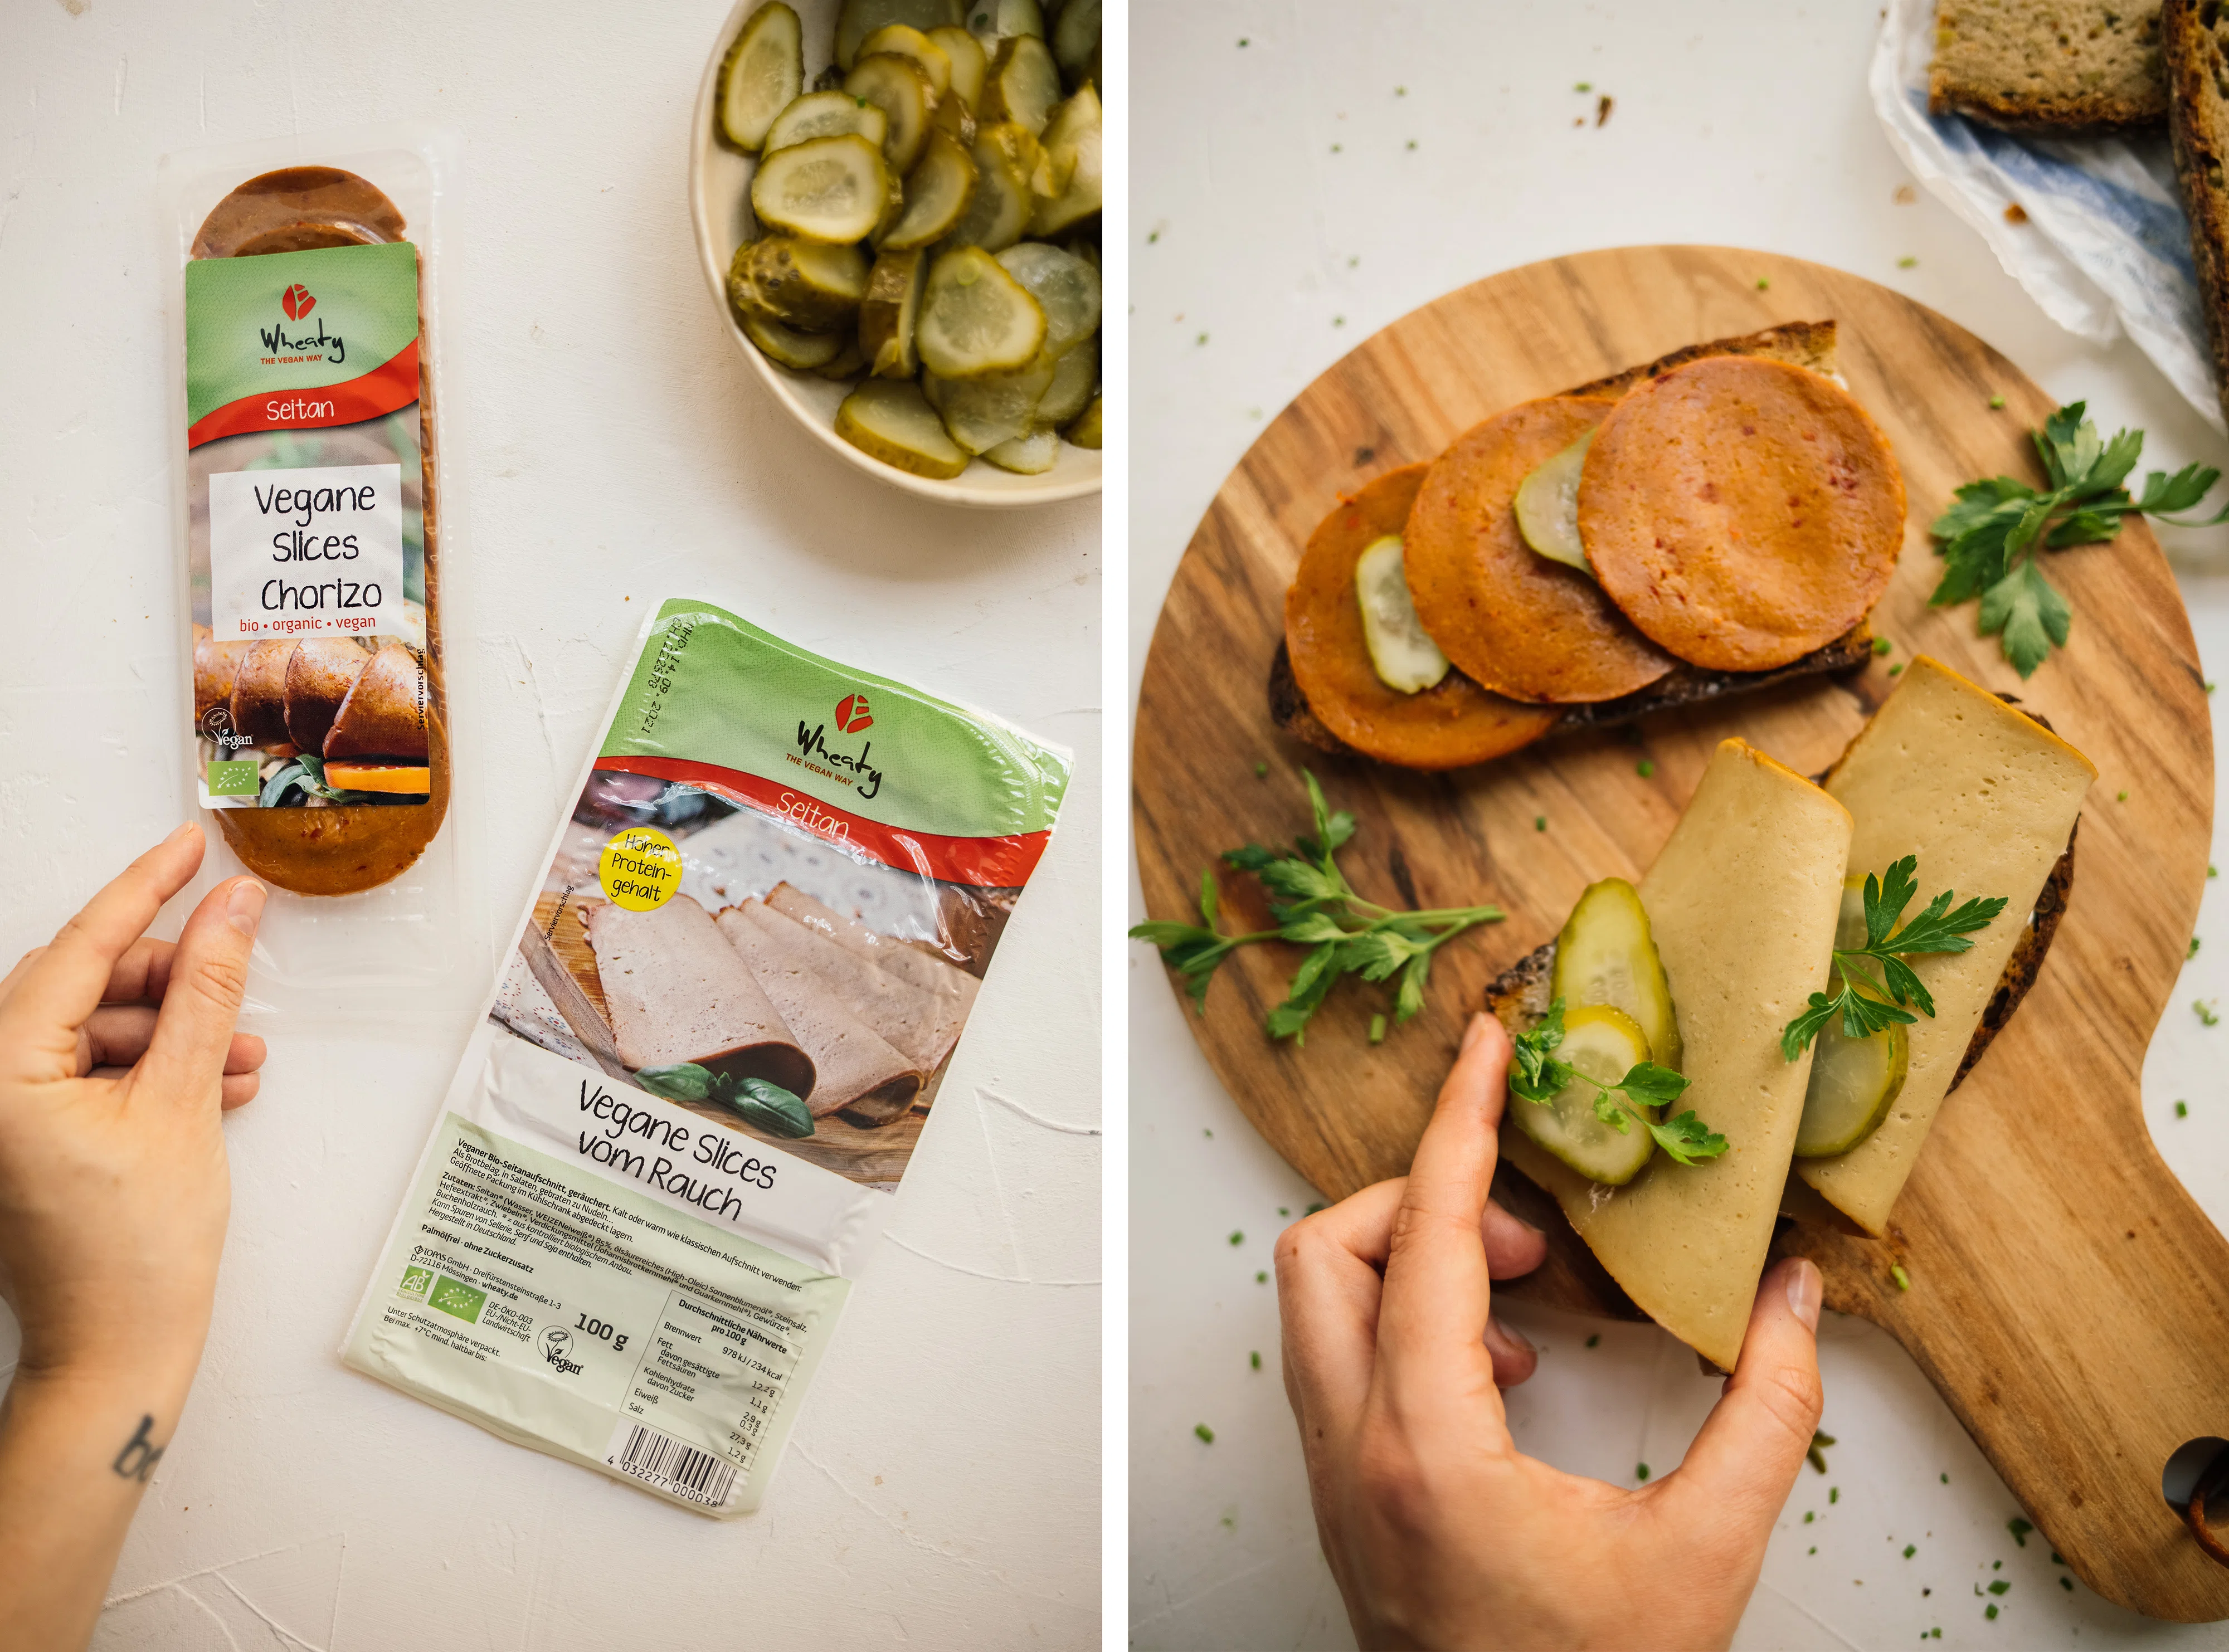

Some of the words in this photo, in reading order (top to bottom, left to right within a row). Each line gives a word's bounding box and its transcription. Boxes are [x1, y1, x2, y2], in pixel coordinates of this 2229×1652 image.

[261, 318, 345, 364] Wheaty
[266, 398, 334, 421] Seitan
[254, 484, 376, 527] Vegane
[272, 530, 359, 563] Slices
[262, 578, 382, 611] Chorizo
[240, 619, 259, 632] bio
[272, 616, 322, 633] organic
[335, 617, 376, 630] vegan
[417, 648, 425, 730] Serviervorschlag
[211, 728, 253, 750] Vegan
[797, 720, 882, 799] Wheaty
[786, 753, 802, 766] THE
[804, 761, 833, 778] VEGAN
[834, 773, 853, 786] WAY
[776, 792, 849, 840] Seitan
[611, 852, 672, 880] Protein-
[611, 879, 661, 901] gehalt
[544, 885, 575, 942] Serviervorschlag
[580, 1078, 689, 1152] Vegane
[692, 1133, 777, 1189] Slices
[450, 1156, 486, 1179] Geöffnete
[485, 1173, 518, 1194] Packung
[516, 1186, 527, 1197] im
[527, 1191, 572, 1216] Kühlschrank
[571, 1211, 610, 1232] abgedeckt
[609, 1225, 633, 1242] lagern.
[452, 1147, 467, 1158] Als
[463, 1152, 500, 1177] Brotbelag,
[501, 1169, 509, 1179] in
[509, 1173, 538, 1192] Salaten,
[538, 1187, 571, 1206] gebraten
[571, 1201, 581, 1210] zu
[578, 1130, 645, 1178] vom
[646, 1156, 742, 1221] Rauch
[427, 1206, 466, 1227] Hergestellt
[464, 1220, 473, 1229] in
[472, 1223, 517, 1245] Deutschland.
[431, 1197, 450, 1210] Kann
[449, 1204, 475, 1220] Spuren
[474, 1214, 488, 1225] von
[487, 1218, 513, 1235] Sellerie,
[513, 1228, 532, 1242] Senf
[529, 1236, 545, 1246] und
[542, 1241, 558, 1253] Soja
[557, 1249, 591, 1268] enthalten.
[435, 1188, 497, 1218] Buchenholzrauch.
[512, 1219, 527, 1229] aus
[525, 1223, 566, 1246] kontrolliert
[563, 1240, 609, 1265] biologischem
[607, 1260, 632, 1275] Anbau.
[456, 1137, 488, 1158] Veganer
[487, 1152, 567, 1195] Bio-Seitanaufschnitt,
[566, 1188, 611, 1212] geräuchert.
[611, 1205, 628, 1219] Kalt
[627, 1214, 645, 1225] oder
[645, 1220, 666, 1234] warm
[666, 1229, 680, 1240] wie
[679, 1234, 721, 1258] klassischen
[721, 1252, 761, 1275] Aufschnitt
[761, 1270, 802, 1292] verwenden:
[421, 1223, 461, 1244] Palmölfrei
[463, 1241, 483, 1253] ohne
[482, 1246, 534, 1274] Zuckerzusatz
[441, 1171, 475, 1190] Zutaten:
[502, 1197, 533, 1216] (Wasser,
[595, 1237, 612, 1250] 85%,
[613, 1245, 664, 1272] ölsäurereiches
[664, 1267, 708, 1291] (High-Oleic)
[772, 1312, 807, 1333] Steinsalz,
[528, 1216, 596, 1249] Verdickungsmittel
[678, 1282, 694, 1292] und
[402, 1275, 425, 1292] AB
[410, 1251, 442, 1269] D-72116
[441, 1263, 478, 1284] Mössingen
[481, 1281, 518, 1300] wheaty.de
[446, 1256, 470, 1271] GmbH
[472, 1267, 548, 1304] Dreifürstensteinstraße
[548, 1299, 561, 1309] 1-3
[387, 1305, 407, 1318] Unter
[407, 1312, 470, 1344] Schutzatmosphäre
[470, 1338, 500, 1357] verpackt.
[481, 1315, 531, 1342] Landwirtschaft
[484, 1308, 531, 1335] EU-/Nicht-EU-
[488, 1300, 533, 1324] DE-ÖKO-003
[573, 1312, 614, 1341] 100
[612, 1333, 629, 1352] g
[678, 1298, 746, 1333] Durchschnittliche
[743, 1328, 787, 1354] Nährwerte
[710, 1324, 725, 1334] pro
[724, 1328, 741, 1341] 100
[739, 1337, 747, 1346] g
[383, 1314, 396, 1324] Bei
[394, 1319, 411, 1329] max.
[414, 1325, 431, 1337] +7°C
[430, 1333, 450, 1346] mind.
[450, 1339, 475, 1356] haltbar
[474, 1350, 487, 1362] bis:
[546, 1342, 581, 1376] Vegan
[660, 1348, 683, 1363] davon
[681, 1359, 720, 1378] gesättigte
[663, 1320, 702, 1343] Brennwert
[722, 1346, 738, 1358] 978
[737, 1352, 747, 1363] kJ
[750, 1360, 767, 1373] 234
[766, 1367, 783, 1381] kcal
[656, 1336, 673, 1350] Fett
[751, 1380, 770, 1393] 12,2
[768, 1389, 775, 1398] g
[656, 1355, 696, 1378] Fettsäuren
[749, 1396, 762, 1409] 1,1
[761, 1405, 768, 1414] g
[634, 1387, 659, 1405] Eiweiß
[729, 1431, 746, 1445] 27,3
[744, 1441, 752, 1450] g
[643, 1366, 695, 1393] Kohlenhydrate
[742, 1411, 756, 1423] 2,9
[754, 1420, 761, 1428] g
[646, 1377, 669, 1391] davon
[668, 1385, 694, 1402] Zucker
[739, 1419, 753, 1431] 0,3
[751, 1427, 758, 1436] g
[628, 1401, 644, 1415] Salz
[727, 1446, 741, 1459] 1,2
[739, 1454, 746, 1464] g
[621, 1461, 668, 1487] 032277
